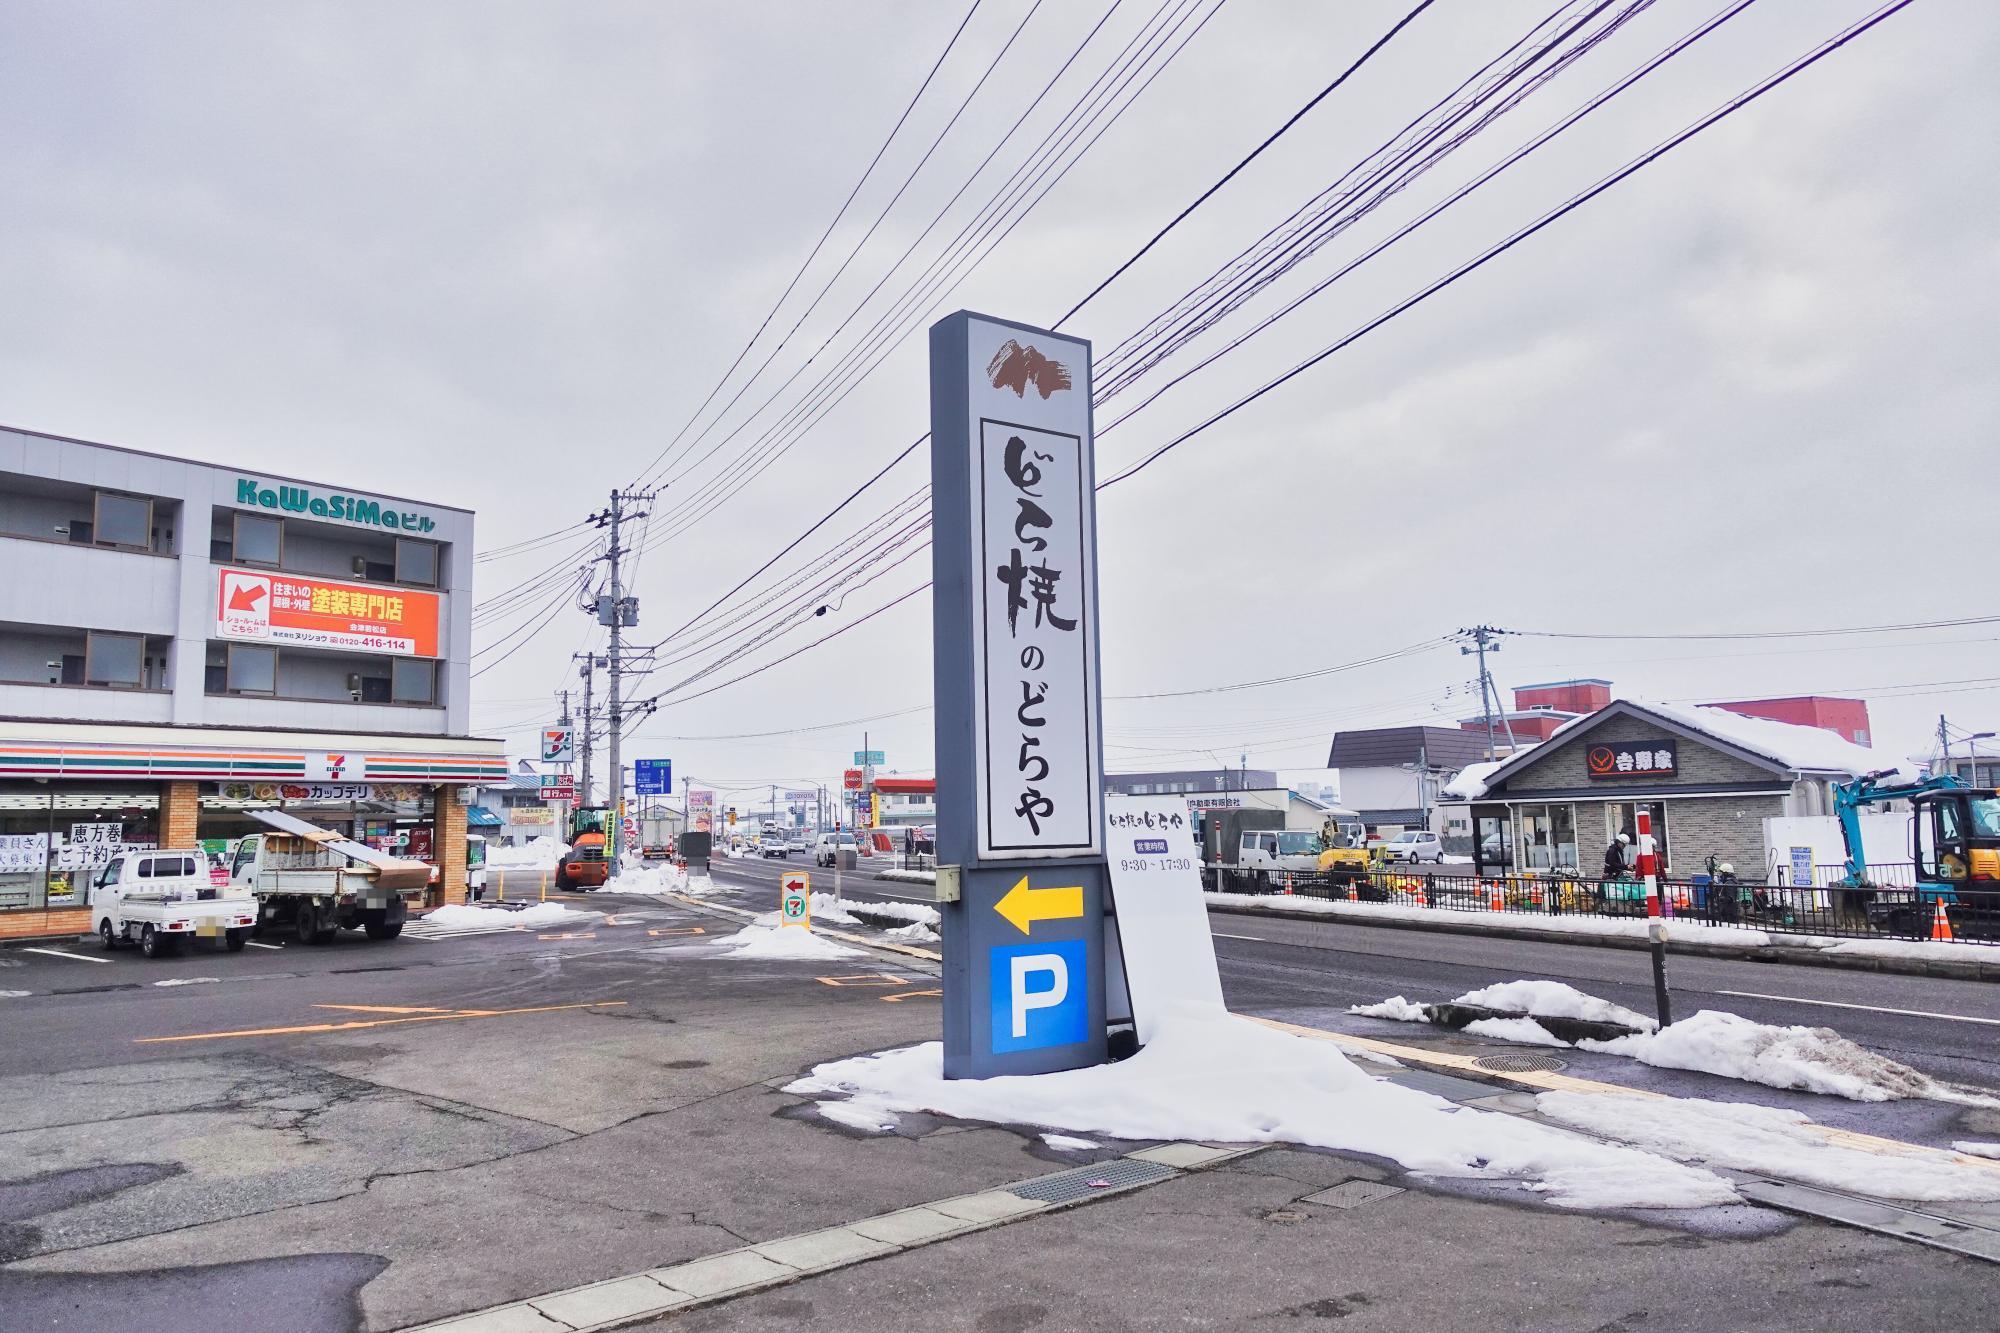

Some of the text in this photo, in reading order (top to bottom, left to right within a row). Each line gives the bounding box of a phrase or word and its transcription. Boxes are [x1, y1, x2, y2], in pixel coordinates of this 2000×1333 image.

[273, 582, 311, 598] 住まいの
[311, 587, 404, 622] 塗装専門店
[310, 785, 368, 799] カップデリ
[72, 824, 121, 843] 恵方巻
[1136, 842, 1166, 851] 営業時間
[1010, 953, 1069, 1038] P
